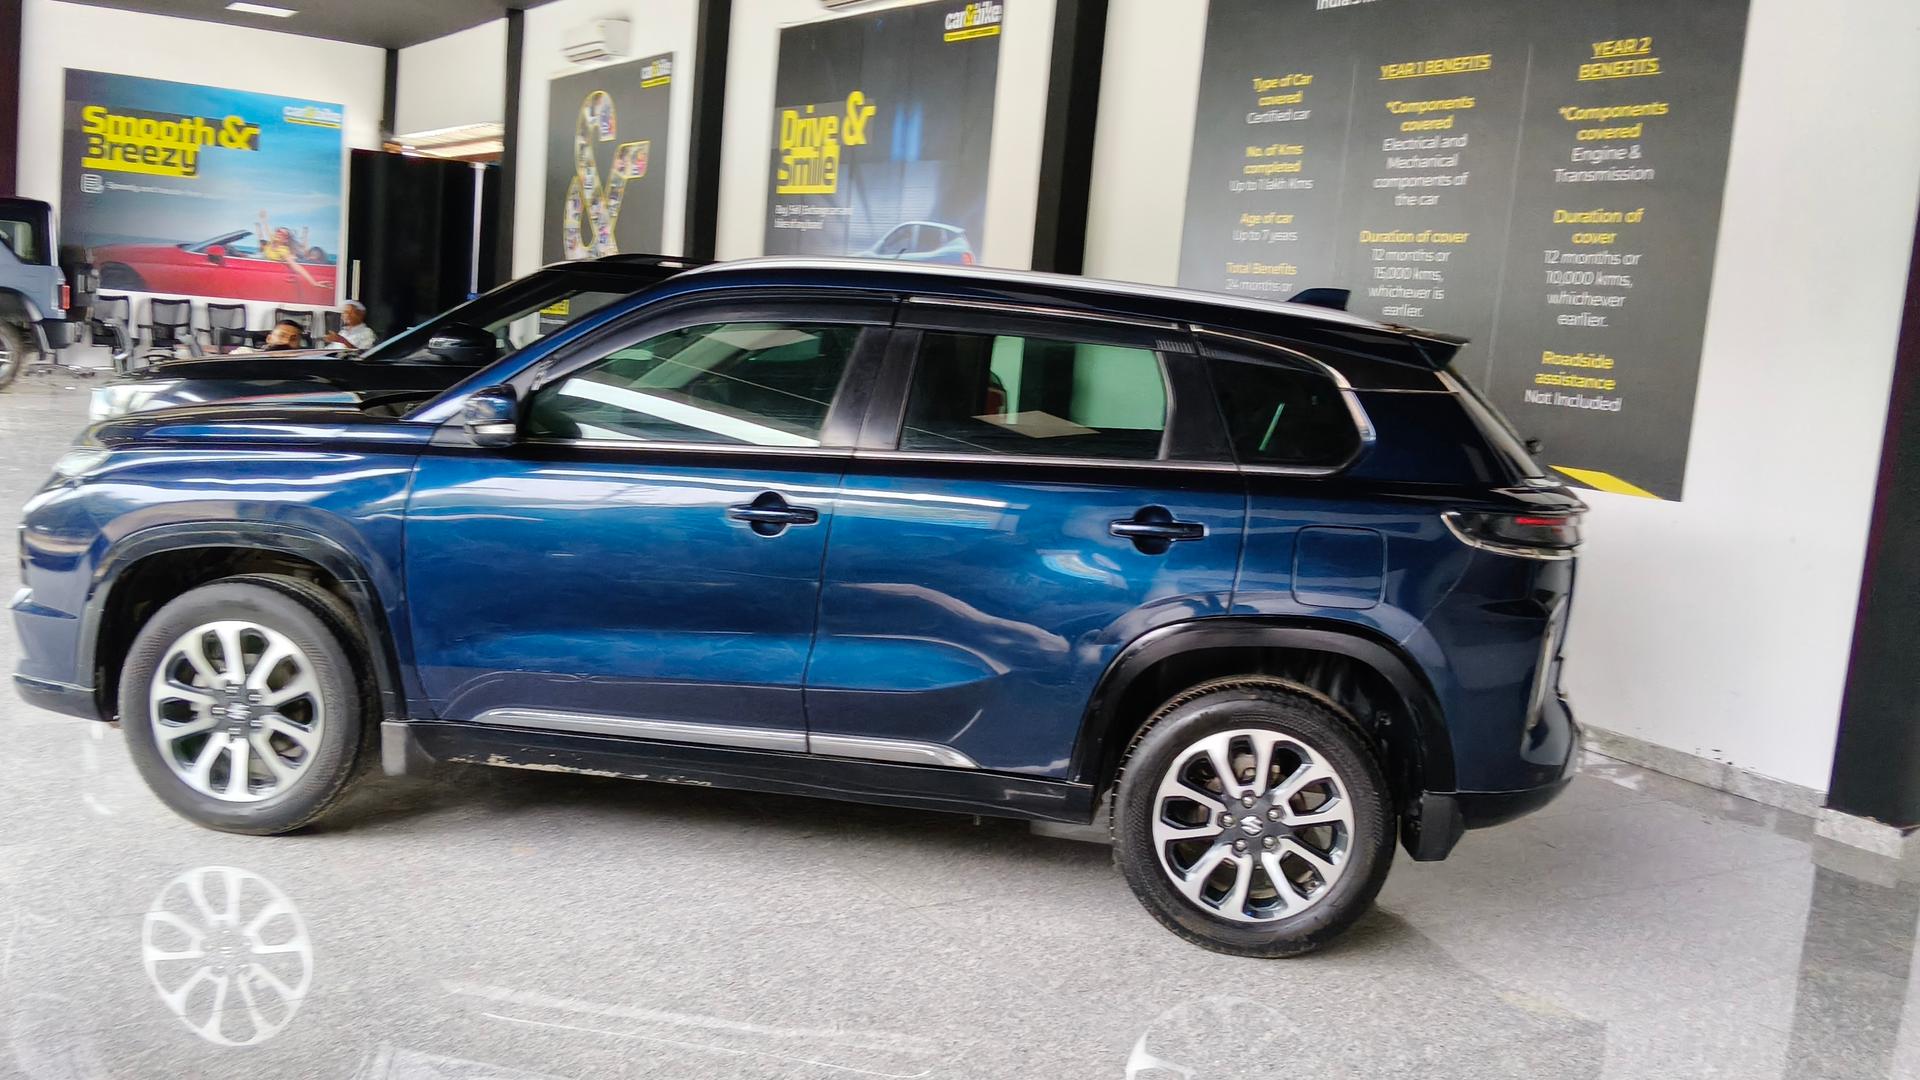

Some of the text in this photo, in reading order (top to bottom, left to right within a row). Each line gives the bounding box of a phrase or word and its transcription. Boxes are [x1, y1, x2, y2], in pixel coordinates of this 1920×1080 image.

[1590, 37, 1653, 59] YEAR 2
[1379, 62, 1414, 80] YEAR
[1424, 54, 1492, 76] BENEFITS
[1577, 58, 1663, 81] BENEFITS
[1252, 74, 1313, 92] Type of Car
[1258, 90, 1303, 106] covered
[781, 90, 876, 150] Drive &
[1246, 110, 1312, 124] Certified car
[1401, 115, 1455, 132] covered
[82, 105, 261, 150] Smooth &
[1576, 122, 1643, 140] covered
[1264, 144, 1279, 156] of
[1382, 134, 1469, 151] Electrical and
[84, 133, 198, 177] Breezy
[1386, 153, 1460, 169] Mechanical
[1571, 144, 1642, 164] Engine &
[1243, 160, 1302, 176] completed
[1553, 166, 1655, 182] Transmission
[1373, 172, 1470, 190] components of
[1394, 193, 1440, 206] the car
[1240, 212, 1295, 227] Age of car
[1553, 207, 1645, 224] Duration of
[1360, 229, 1470, 244] Duration of cover
[1571, 232, 1617, 245] cover
[1371, 248, 1451, 262] 12 months or
[1544, 250, 1642, 265] 12 months or
[1225, 262, 1297, 275] Total Benefits
[1545, 271, 1633, 288] 10,000 kms,
[1368, 285, 1445, 300] whichever is
[1546, 290, 1626, 307] whichever
[1556, 312, 1608, 327] earlier.
[1542, 350, 1615, 369] Roadside
[1534, 371, 1616, 390] assistance
[1524, 390, 1623, 411] Not Included
